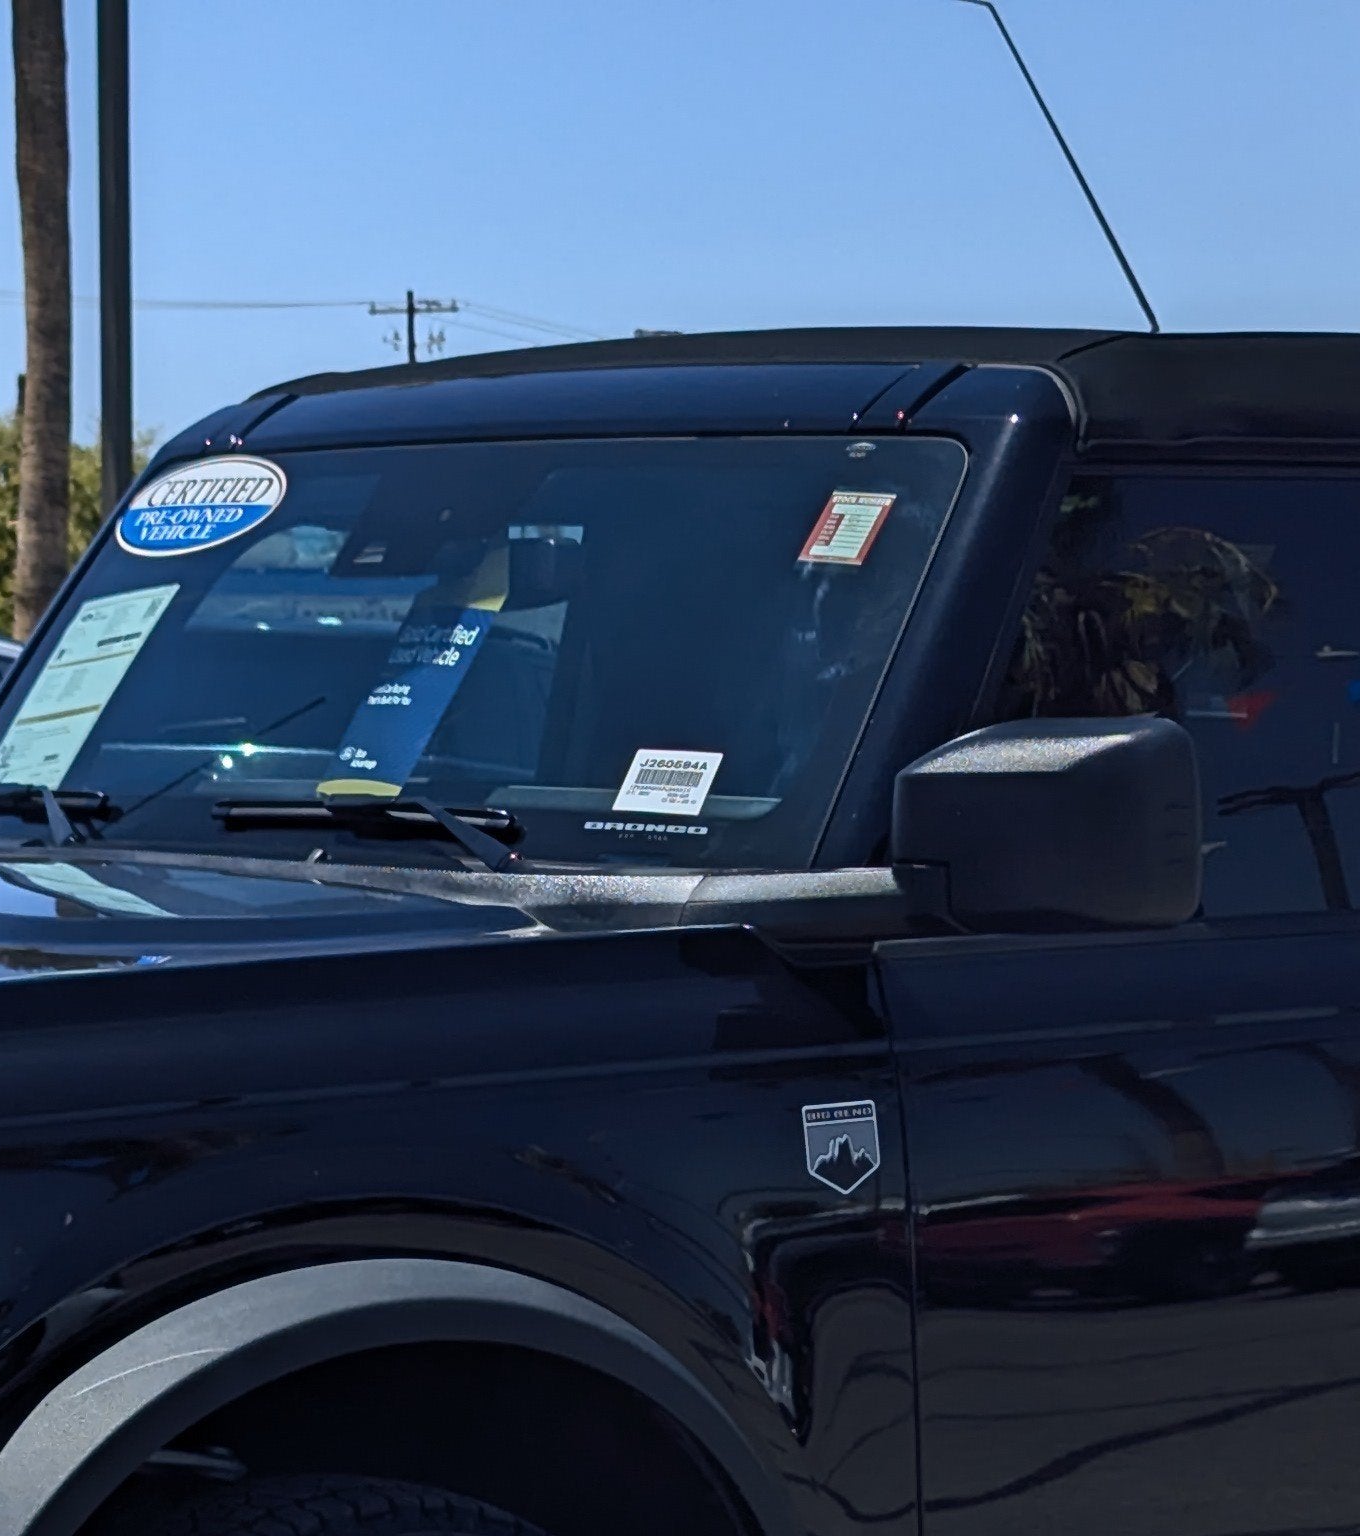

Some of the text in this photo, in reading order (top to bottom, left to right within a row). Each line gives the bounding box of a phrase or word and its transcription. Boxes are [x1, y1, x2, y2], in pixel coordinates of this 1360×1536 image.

[147, 477, 274, 507] CERTIFIED
[134, 507, 244, 527] PRE-OWNED
[139, 523, 217, 541] VEHICLE
